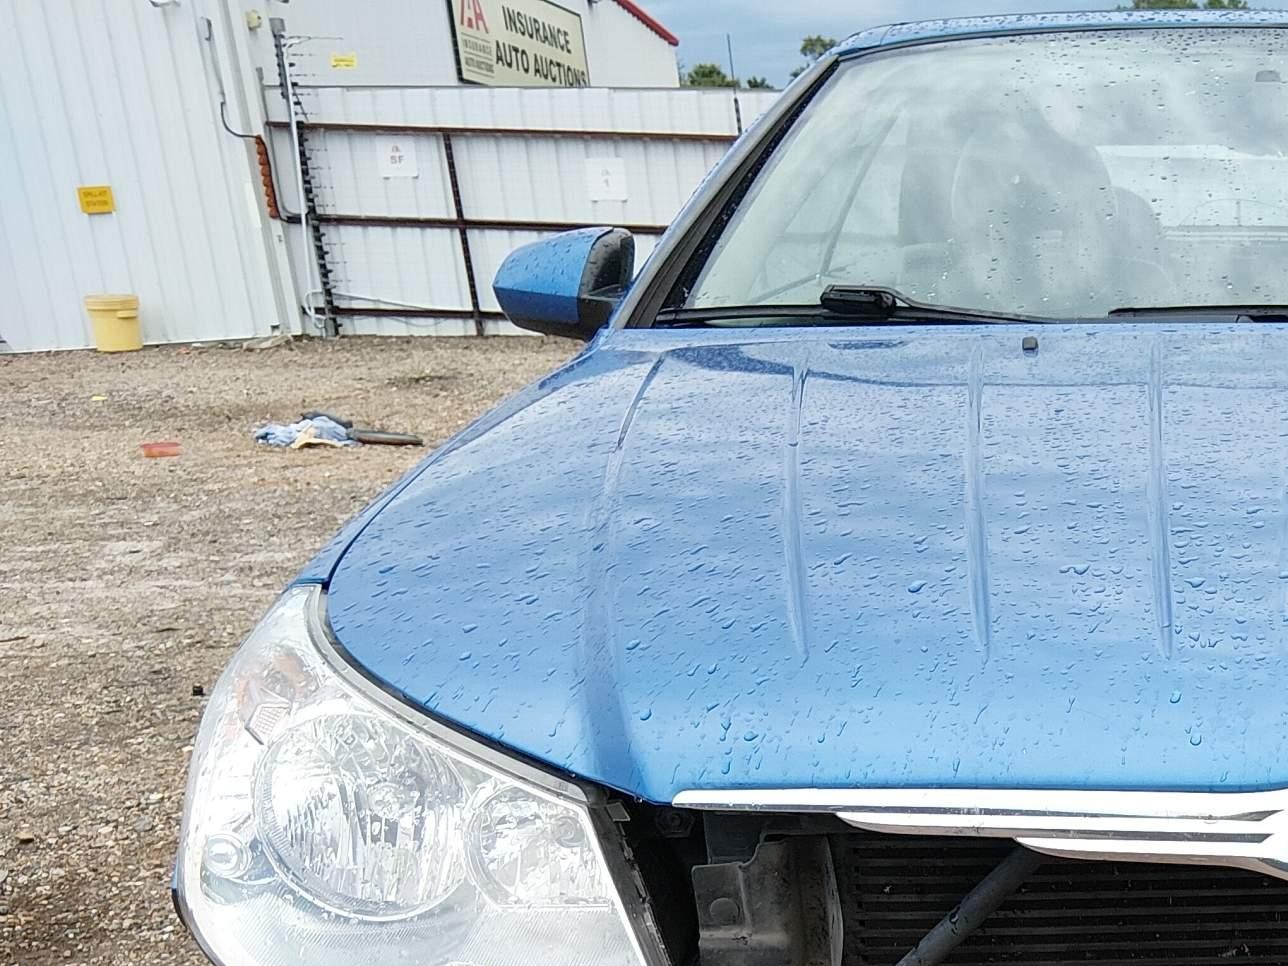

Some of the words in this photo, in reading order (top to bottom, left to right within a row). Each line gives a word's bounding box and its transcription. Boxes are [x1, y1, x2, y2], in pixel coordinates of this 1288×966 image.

[501, 5, 572, 54] INSURANCE
[495, 40, 530, 74] AUTO
[533, 53, 588, 87] AUCTIONS
[390, 154, 404, 165] SF
